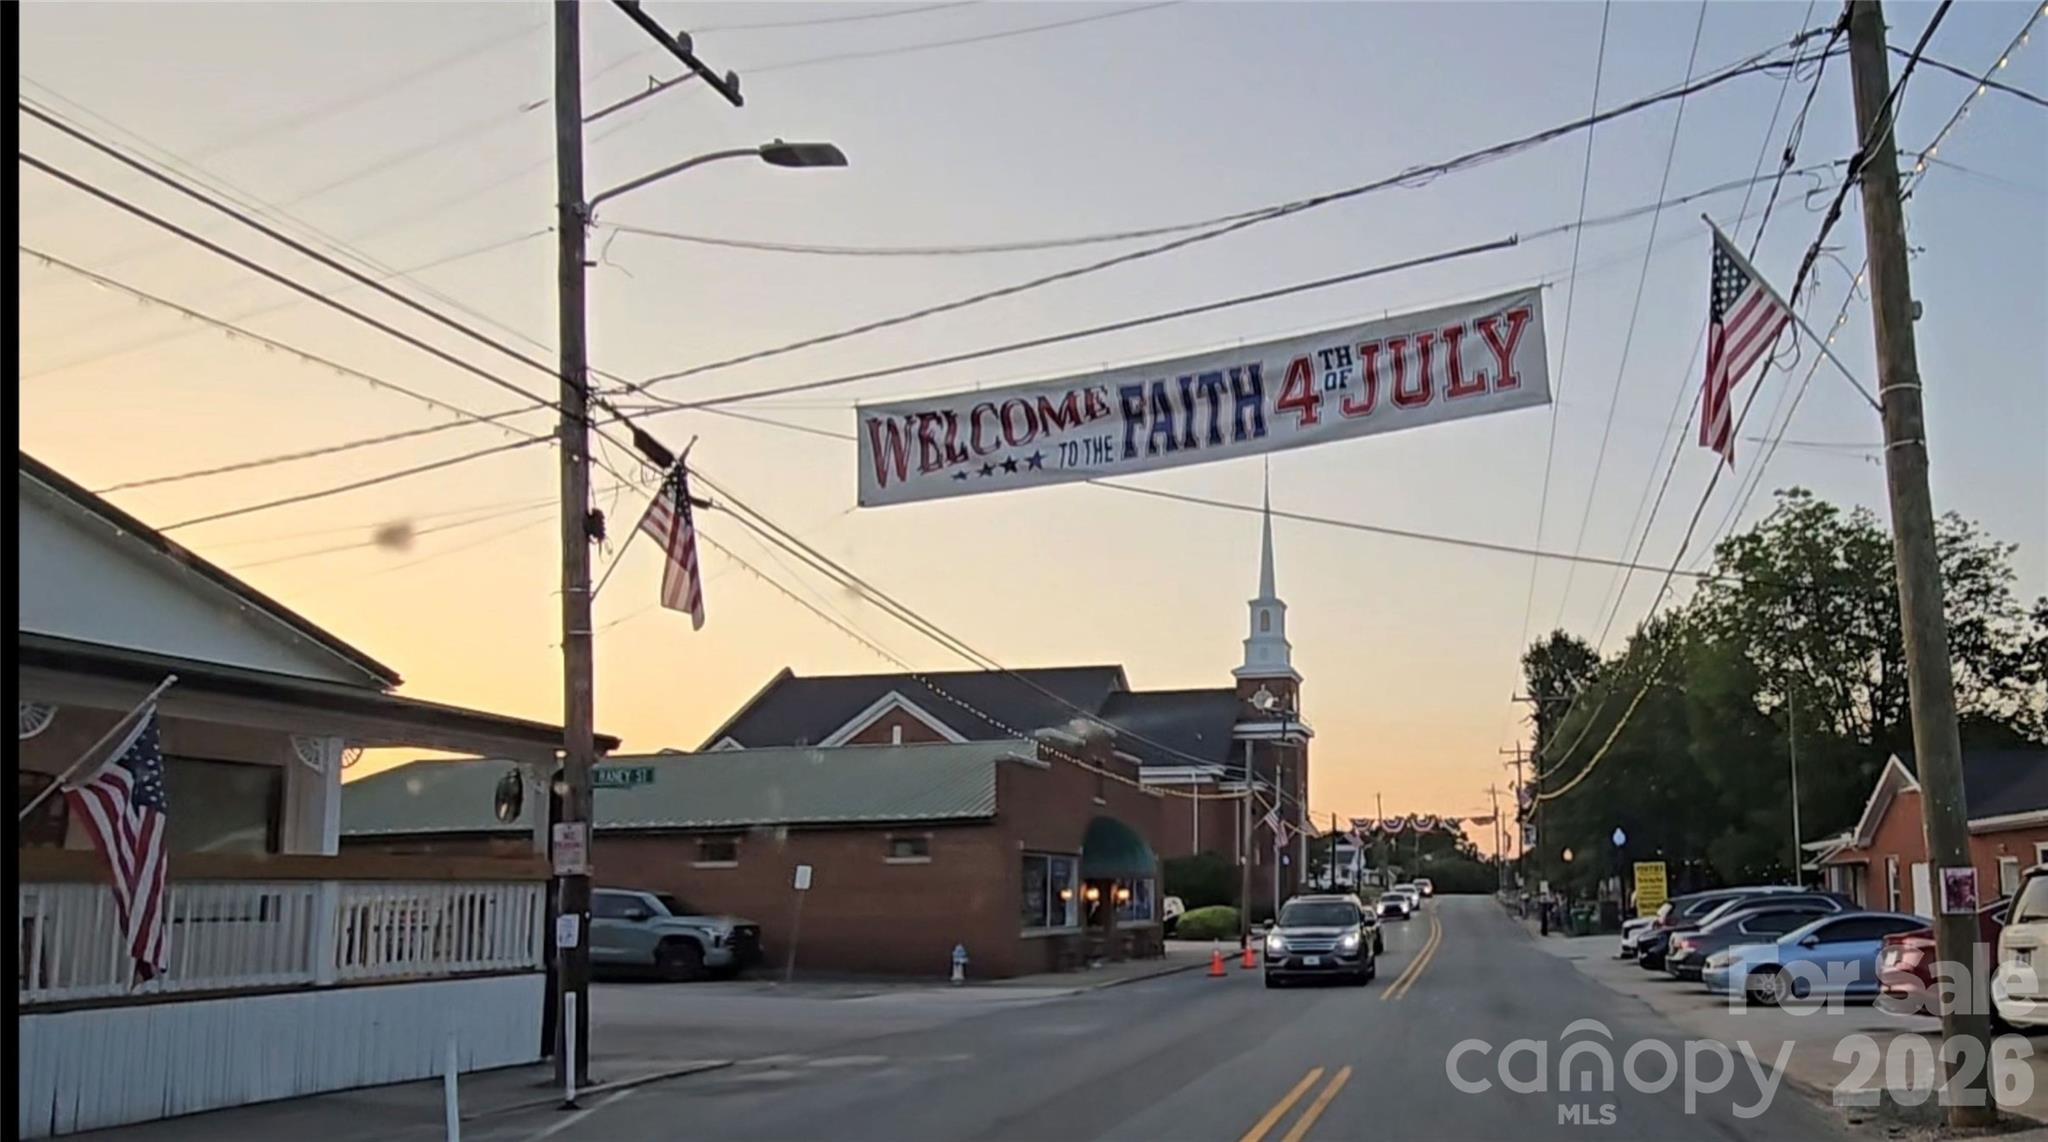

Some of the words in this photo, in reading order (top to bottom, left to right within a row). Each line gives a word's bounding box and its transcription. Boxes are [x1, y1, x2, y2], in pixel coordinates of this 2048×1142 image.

[1119, 361, 1267, 460] FAITH
[1324, 368, 1350, 391] OF
[1339, 304, 1533, 419] JULY
[867, 384, 1111, 489] WELCOME
[1059, 443, 1079, 469] TO
[1083, 436, 1113, 466] THE
